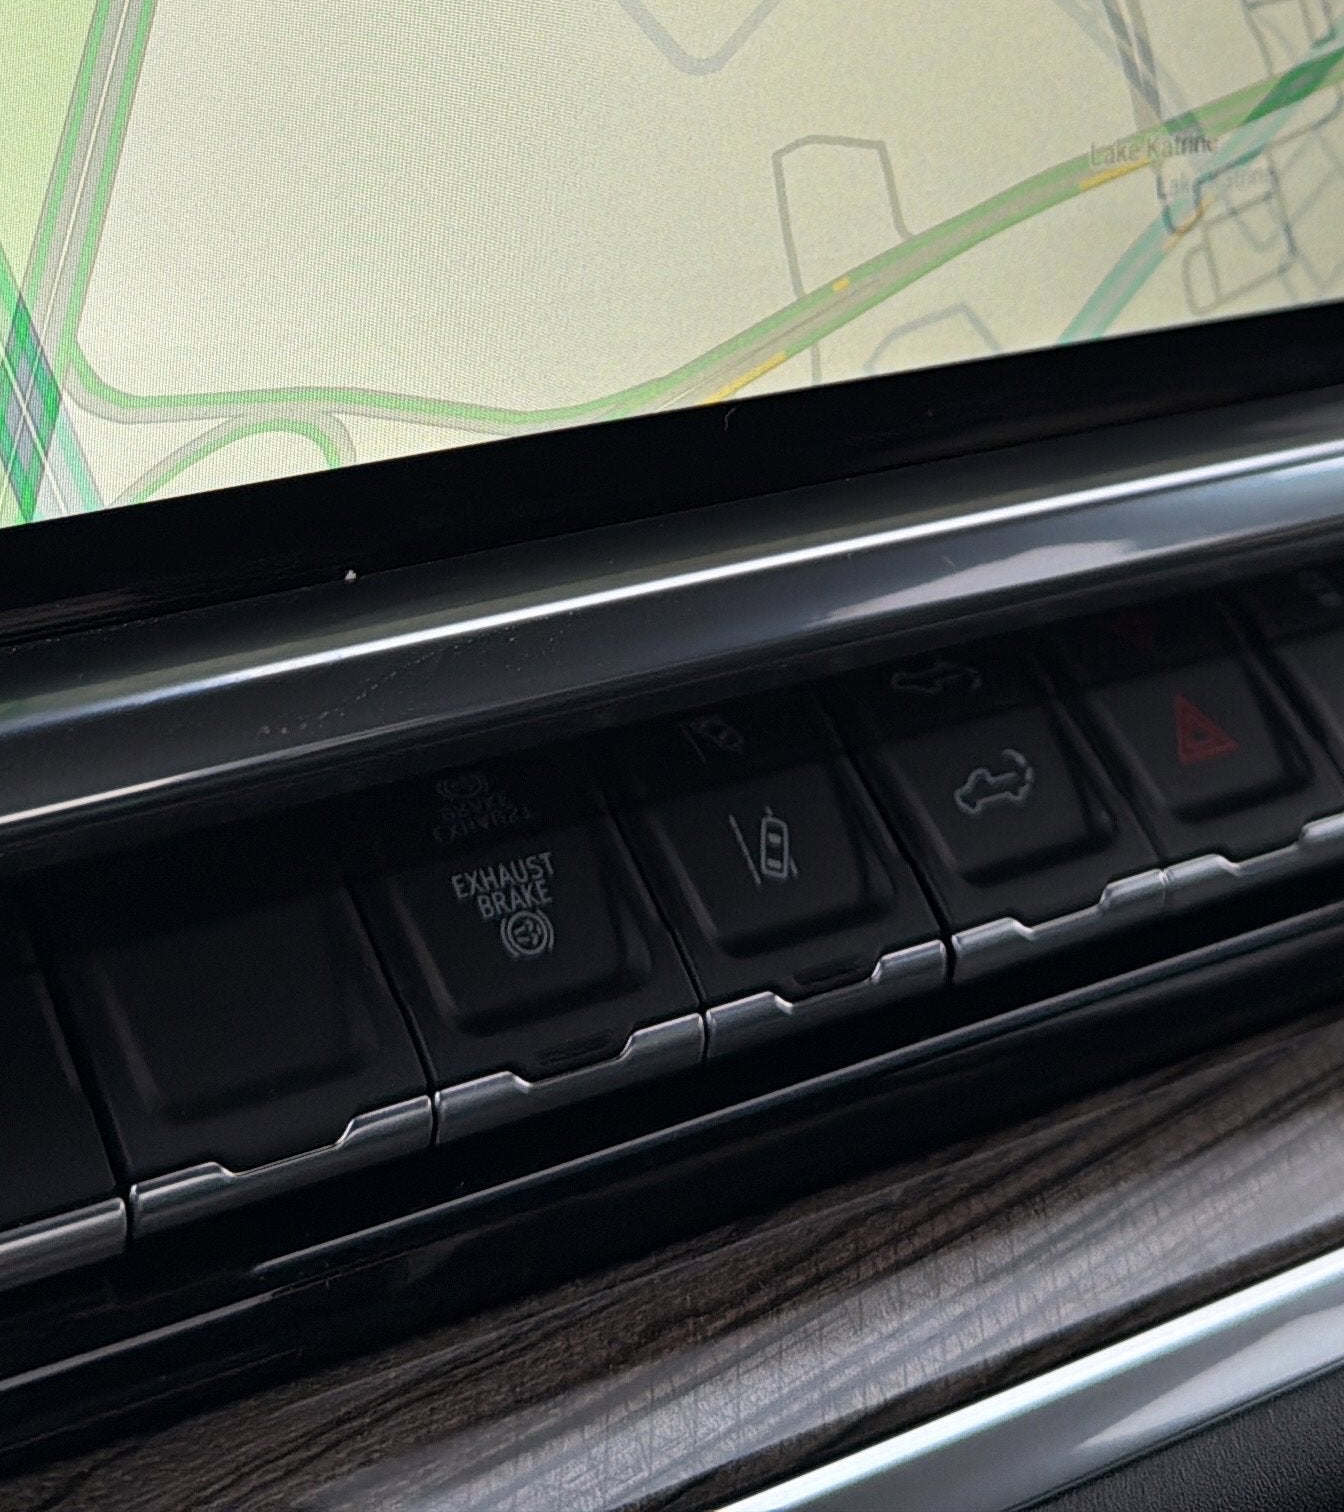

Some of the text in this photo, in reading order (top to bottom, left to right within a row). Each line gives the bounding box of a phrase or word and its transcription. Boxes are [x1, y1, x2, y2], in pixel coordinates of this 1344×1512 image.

[1090, 139, 1140, 167] Lake
[451, 852, 554, 899] EXHAUST
[477, 879, 552, 918] BRAKE
